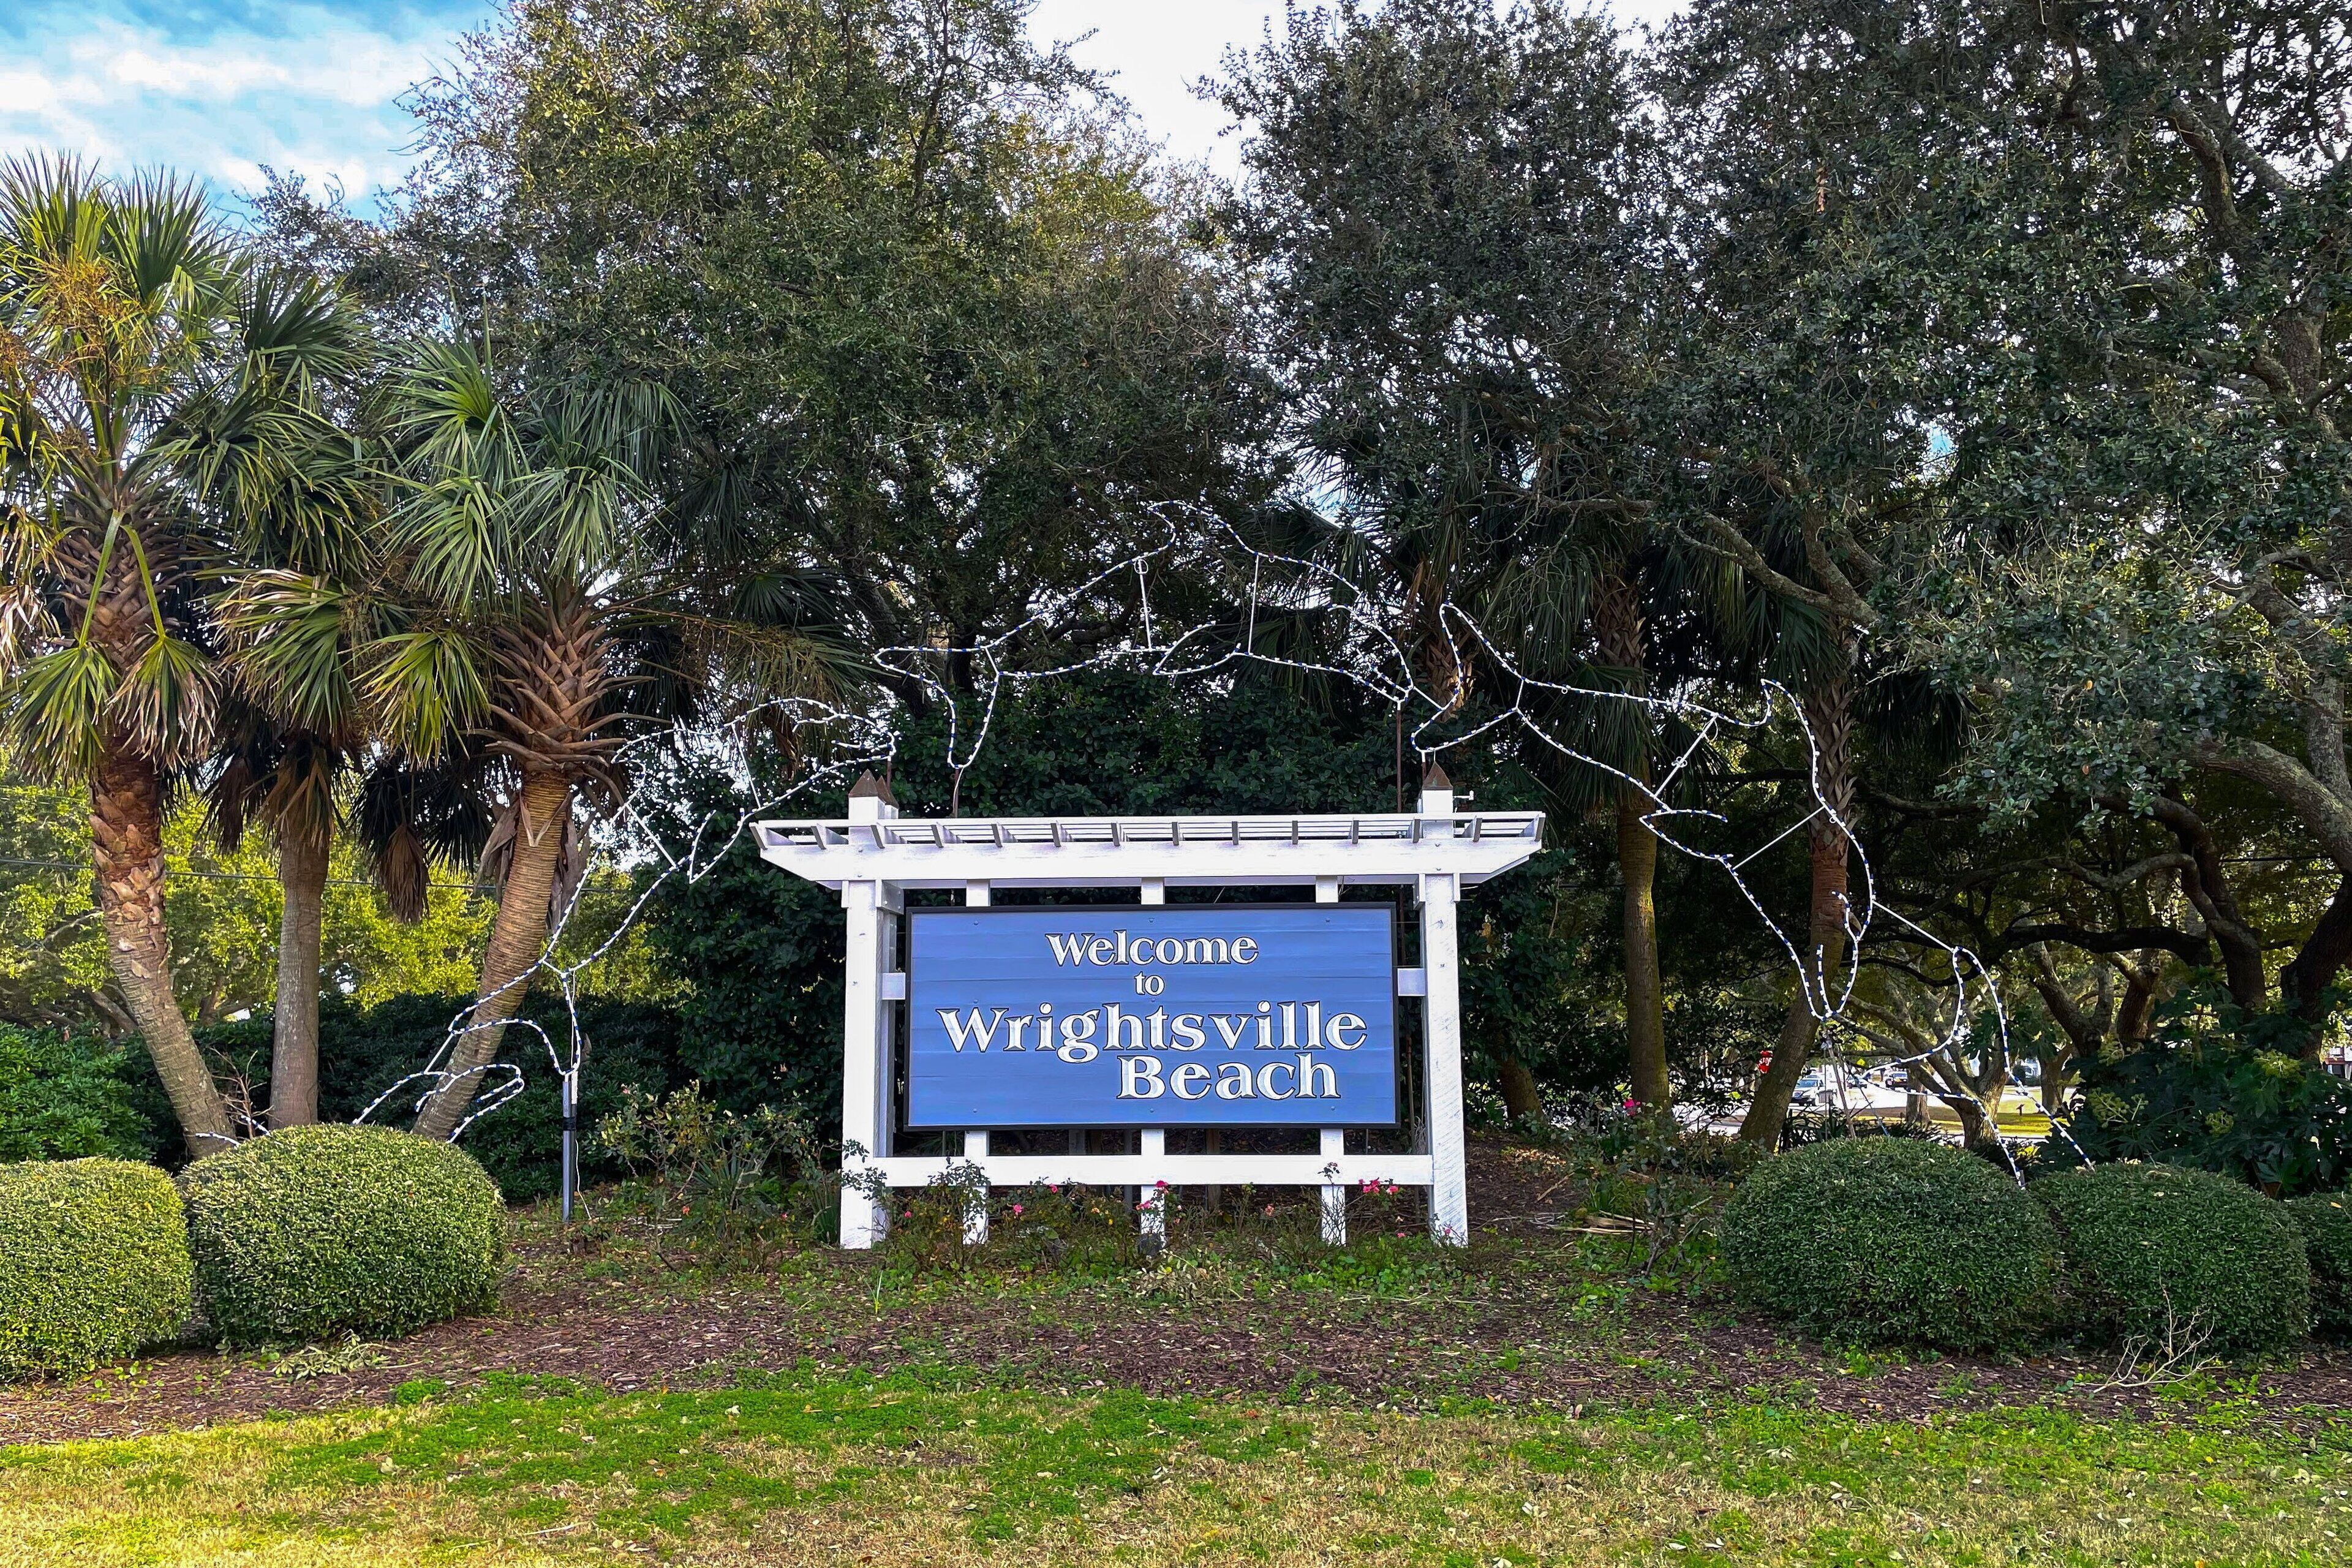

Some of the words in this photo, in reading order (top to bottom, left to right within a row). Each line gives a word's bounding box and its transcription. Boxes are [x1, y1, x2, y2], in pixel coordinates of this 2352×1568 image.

[1045, 929, 1259, 967] Welcome
[1134, 971, 1164, 995] to
[935, 1000, 1368, 1063] Wrightsville
[1117, 1052, 1341, 1100] Beach
